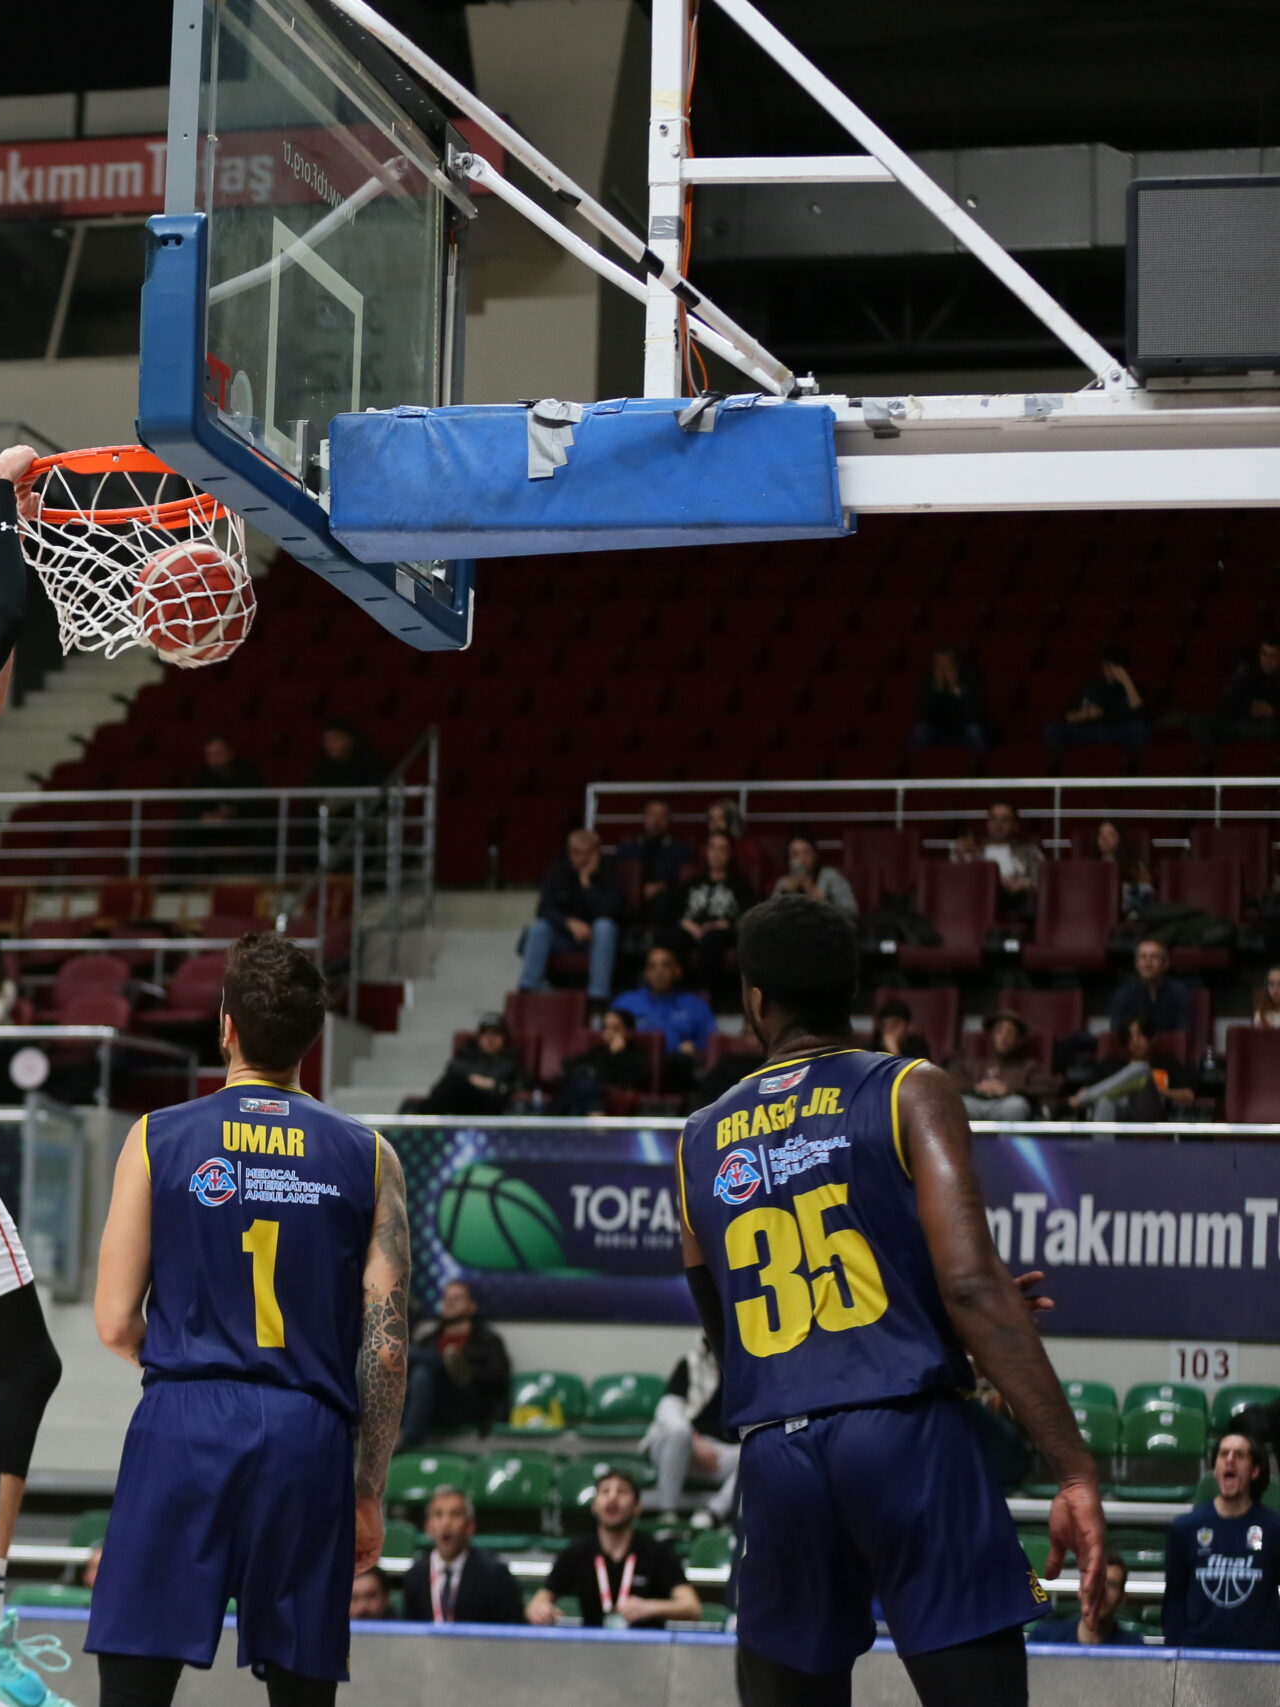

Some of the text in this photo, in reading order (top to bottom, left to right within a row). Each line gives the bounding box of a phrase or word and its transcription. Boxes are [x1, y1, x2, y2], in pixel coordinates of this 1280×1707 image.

[801, 1087, 844, 1118] JR.
[223, 1121, 305, 1157] UMAR
[245, 1167, 299, 1181] MEDICAL
[245, 1178, 340, 1196] INTERNATIONAL
[245, 1189, 319, 1205] AMBULANCE
[571, 1184, 683, 1232] TOFA
[984, 1192, 1280, 1270] TakımımT
[242, 1219, 285, 1347] 1
[725, 1183, 889, 1357] 35
[1178, 1347, 1231, 1381] 103
